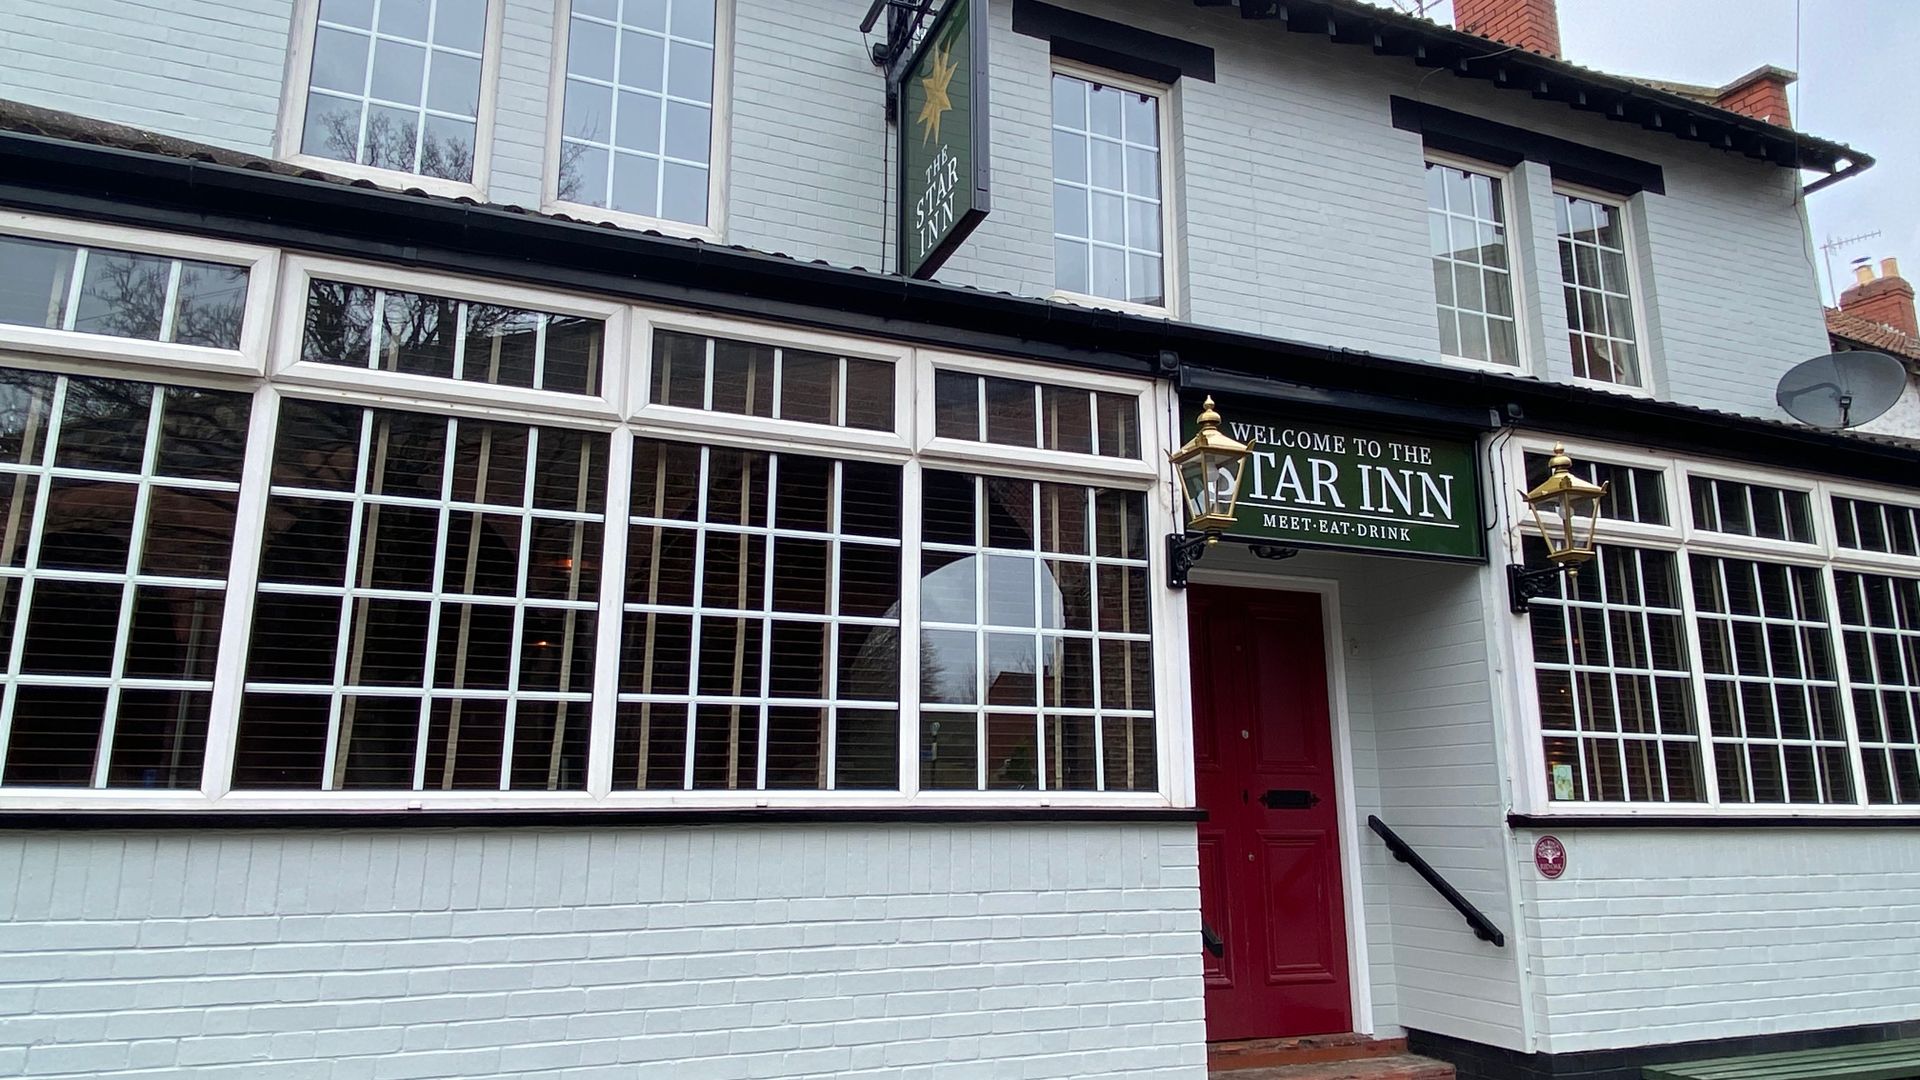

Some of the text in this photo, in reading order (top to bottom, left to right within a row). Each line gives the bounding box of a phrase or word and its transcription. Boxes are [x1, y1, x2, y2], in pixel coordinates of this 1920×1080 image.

[925, 144, 948, 184] THE
[916, 156, 959, 229] STAR
[919, 192, 955, 258] INN
[1229, 421, 1432, 465] WELCOME TO THE
[1357, 464, 1454, 520] INN
